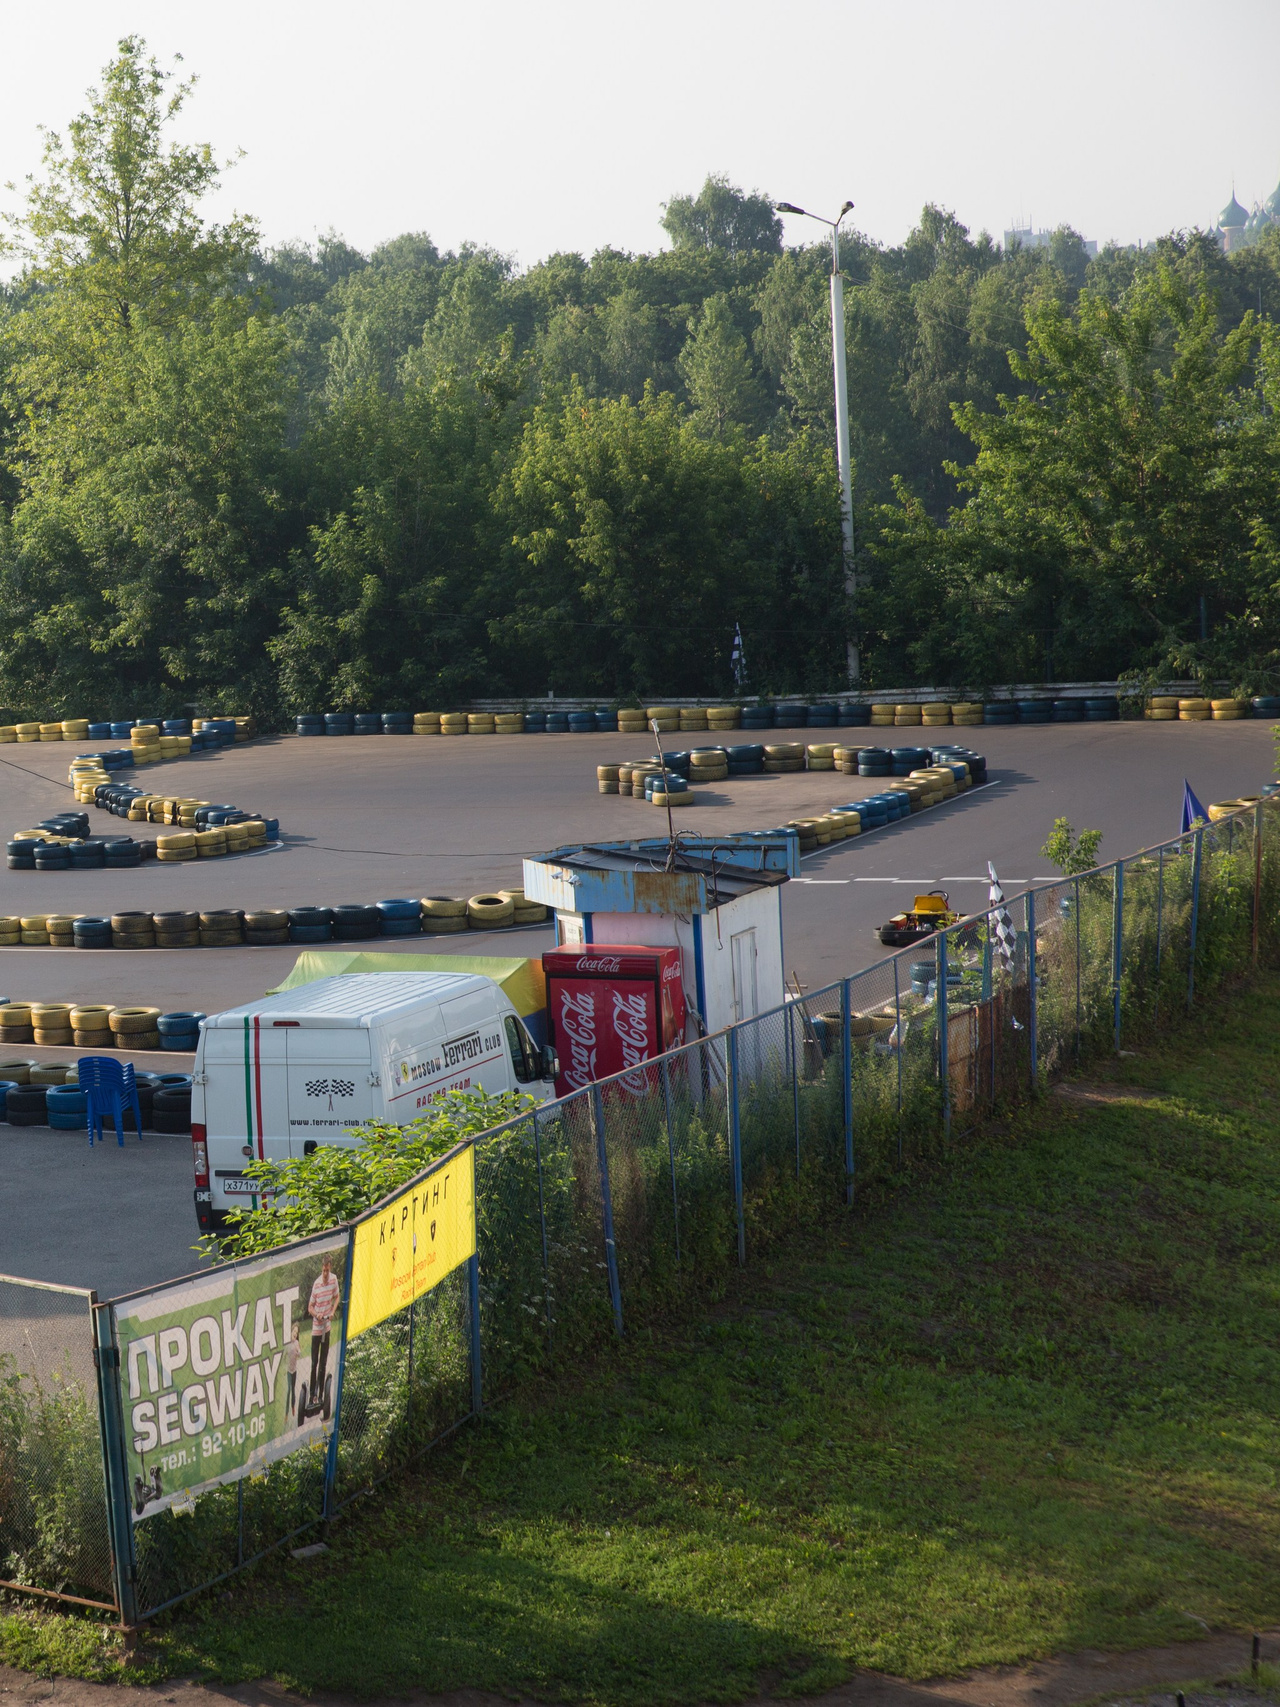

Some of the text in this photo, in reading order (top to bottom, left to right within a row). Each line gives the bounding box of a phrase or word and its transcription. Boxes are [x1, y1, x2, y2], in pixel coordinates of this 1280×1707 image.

[410, 1030, 501, 1081] MOSCOW Ferrari CLUB
[128, 1287, 299, 1400] ПРОКАТ
[131, 1353, 283, 1455] SEGWAY
[160, 1414, 266, 1472] тел.: 92-10-06
